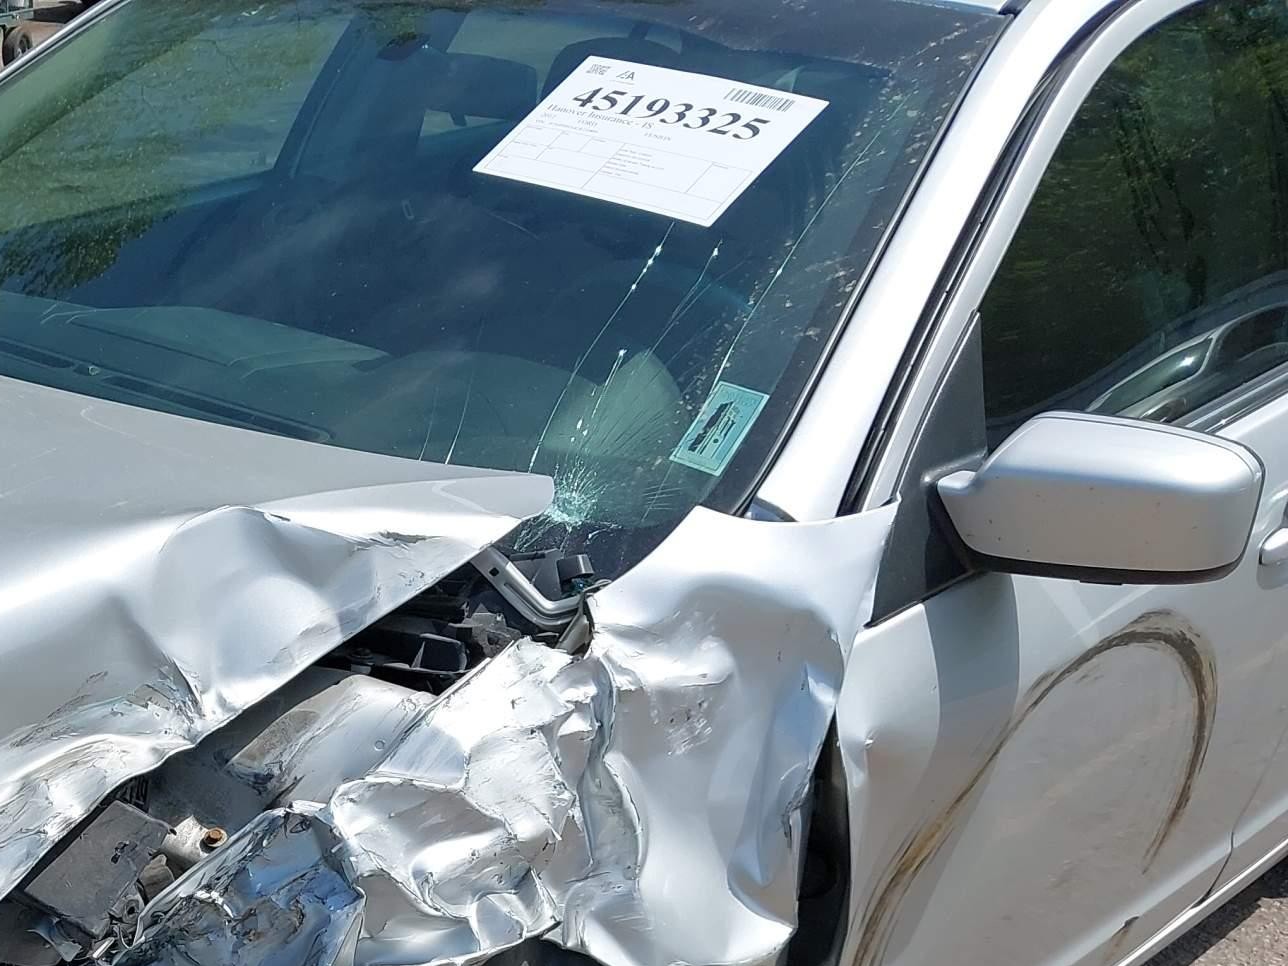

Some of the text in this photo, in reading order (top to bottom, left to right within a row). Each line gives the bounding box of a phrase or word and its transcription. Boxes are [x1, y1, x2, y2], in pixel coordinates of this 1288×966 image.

[547, 103, 587, 117] Hanover
[588, 111, 634, 126] Insurance
[573, 87, 771, 140] 45193325
